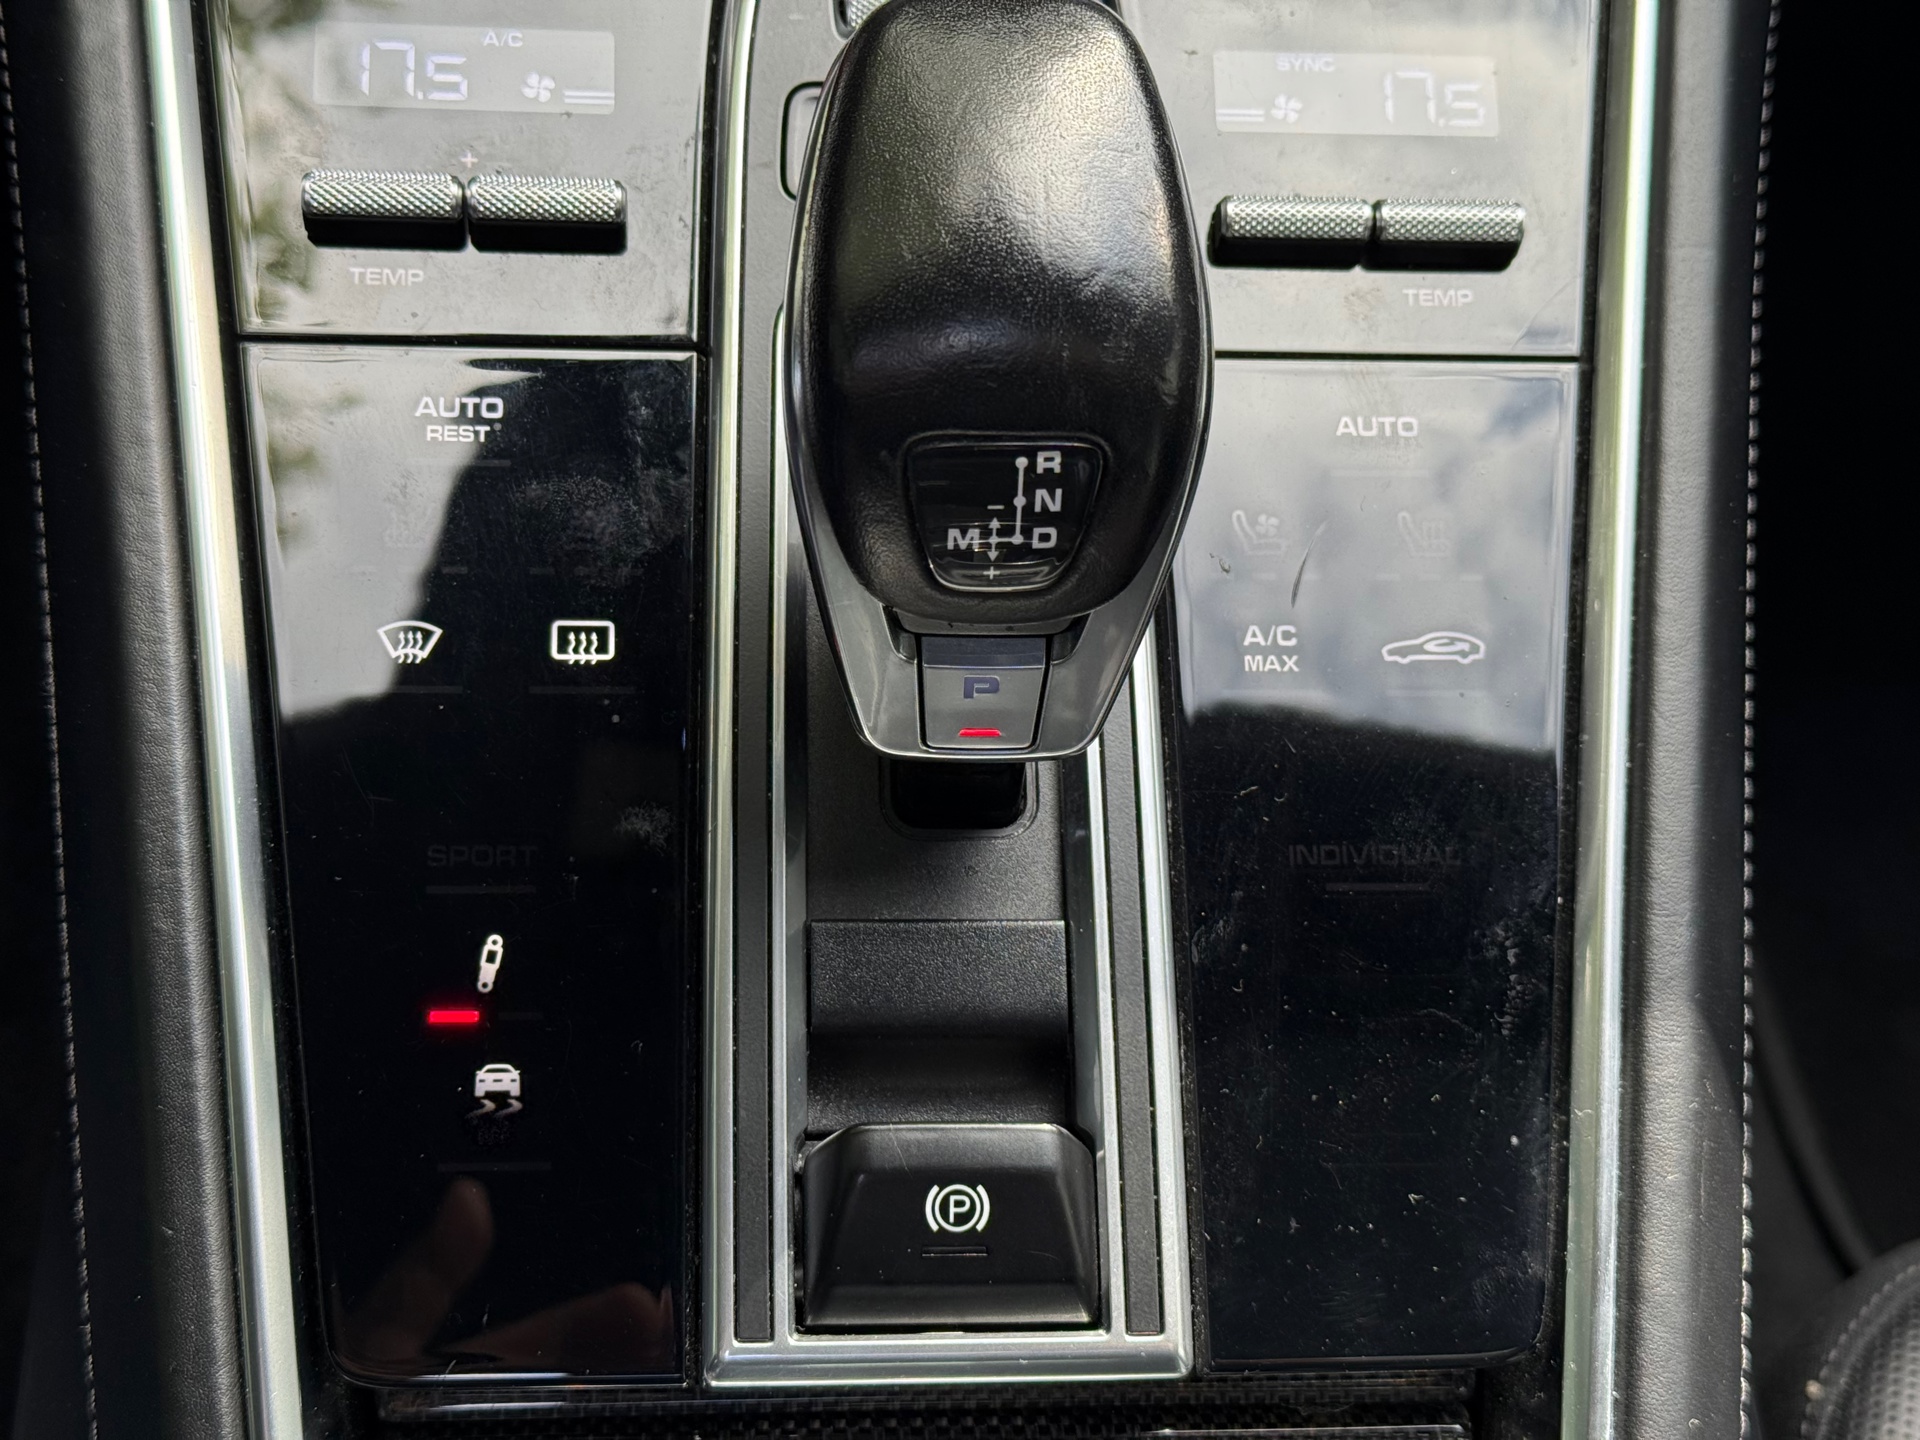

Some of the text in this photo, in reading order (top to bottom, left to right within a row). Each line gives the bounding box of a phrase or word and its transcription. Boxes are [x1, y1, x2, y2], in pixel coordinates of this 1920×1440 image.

[483, 28, 524, 48] A/C
[359, 39, 468, 101] 17.5
[1276, 57, 1336, 72] SYNC
[1383, 70, 1486, 127] 17.5
[349, 267, 424, 287] TEMP
[1402, 288, 1473, 308] TEMP
[415, 396, 504, 419] AUTO
[426, 424, 491, 443] REST
[1336, 416, 1418, 438] AUTO
[1036, 450, 1062, 475] R
[1034, 488, 1063, 512] N
[947, 528, 980, 550] M
[1031, 526, 1058, 549] D
[1243, 624, 1298, 647] A/C
[1244, 654, 1299, 672] MAX
[963, 674, 1000, 699] P
[427, 843, 539, 867] SPORT
[1288, 844, 1462, 867] INDIVIDUAL
